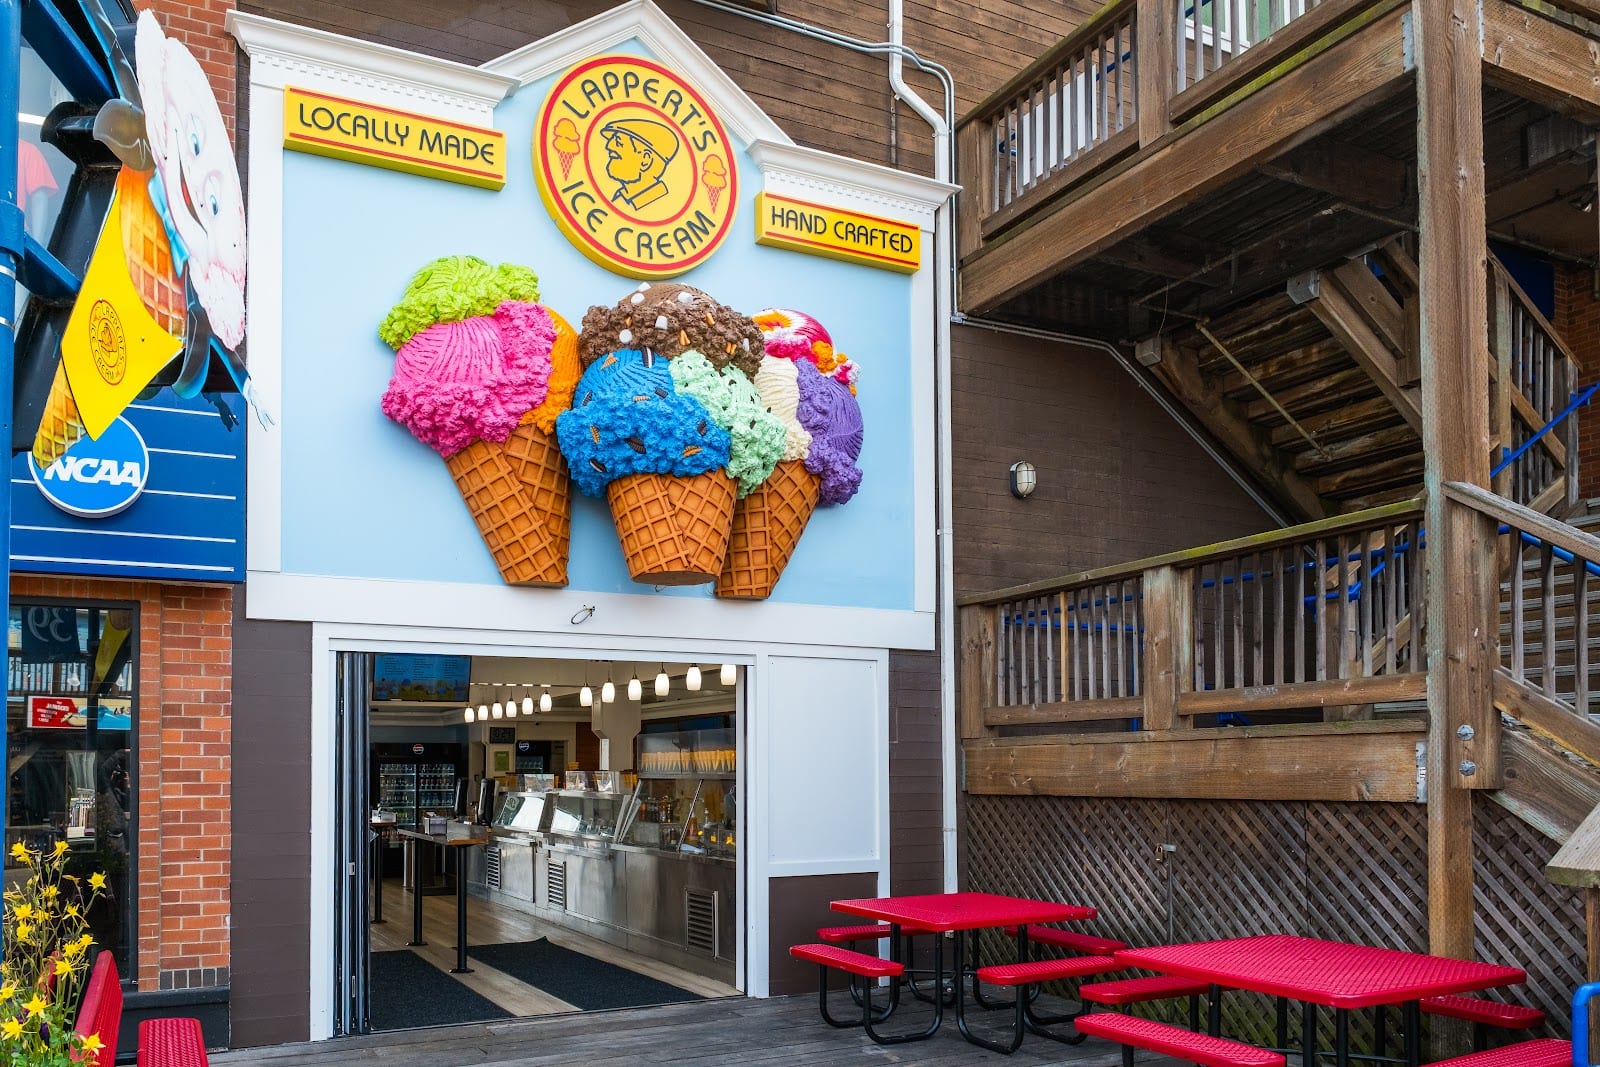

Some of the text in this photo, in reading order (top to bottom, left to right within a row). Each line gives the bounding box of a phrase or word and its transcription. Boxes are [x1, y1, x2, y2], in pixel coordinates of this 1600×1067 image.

[299, 103, 494, 165] LOCALLY MADE
[562, 71, 717, 152] LAPPERT'S
[562, 180, 716, 260] ICE CREAM
[771, 205, 913, 253] HAND CRAFTED
[43, 455, 141, 488] NCAA
